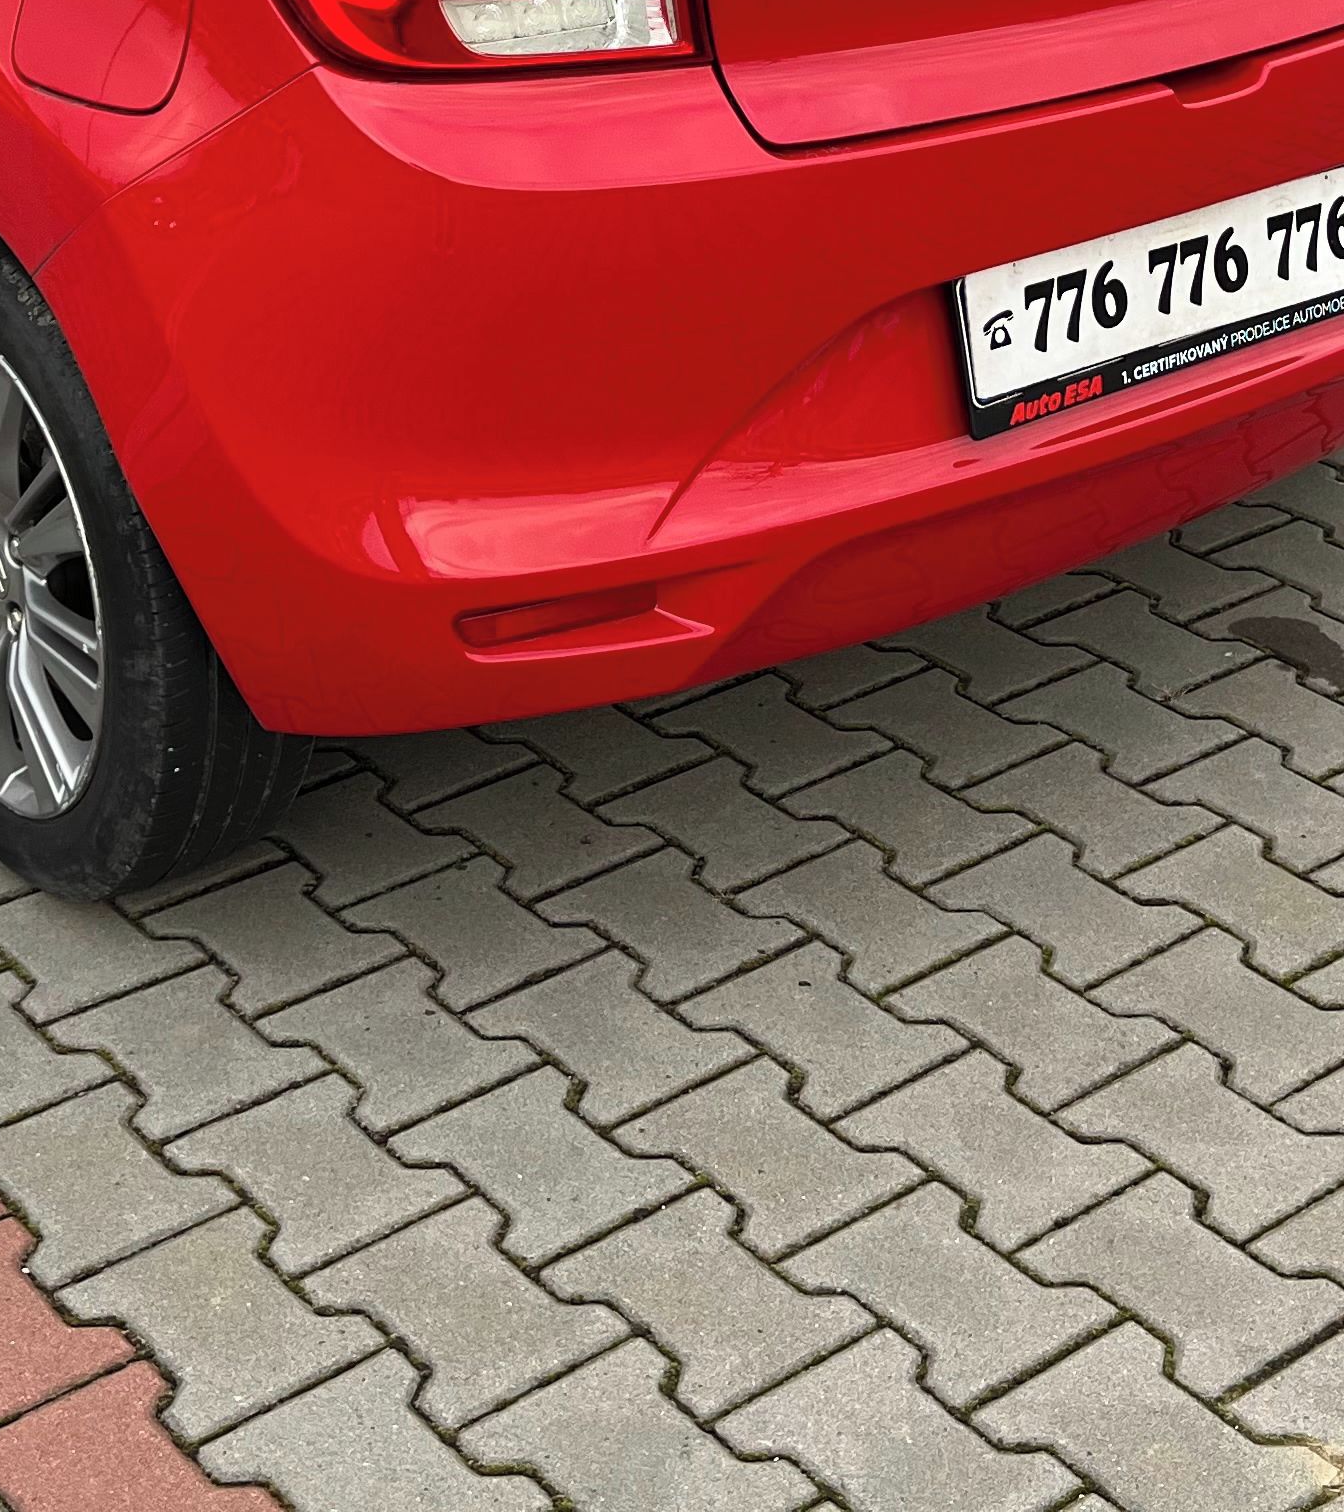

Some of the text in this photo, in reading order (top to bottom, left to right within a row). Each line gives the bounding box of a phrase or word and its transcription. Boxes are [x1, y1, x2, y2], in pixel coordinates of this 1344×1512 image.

[1025, 261, 1128, 352] 776
[1149, 227, 1248, 314] 776
[1121, 370, 1133, 386] 1.
[1133, 334, 1229, 381] CERTIFIKOVANÝ
[1230, 314, 1291, 348] PRODEJCE
[1009, 374, 1104, 426] Auto ESA
